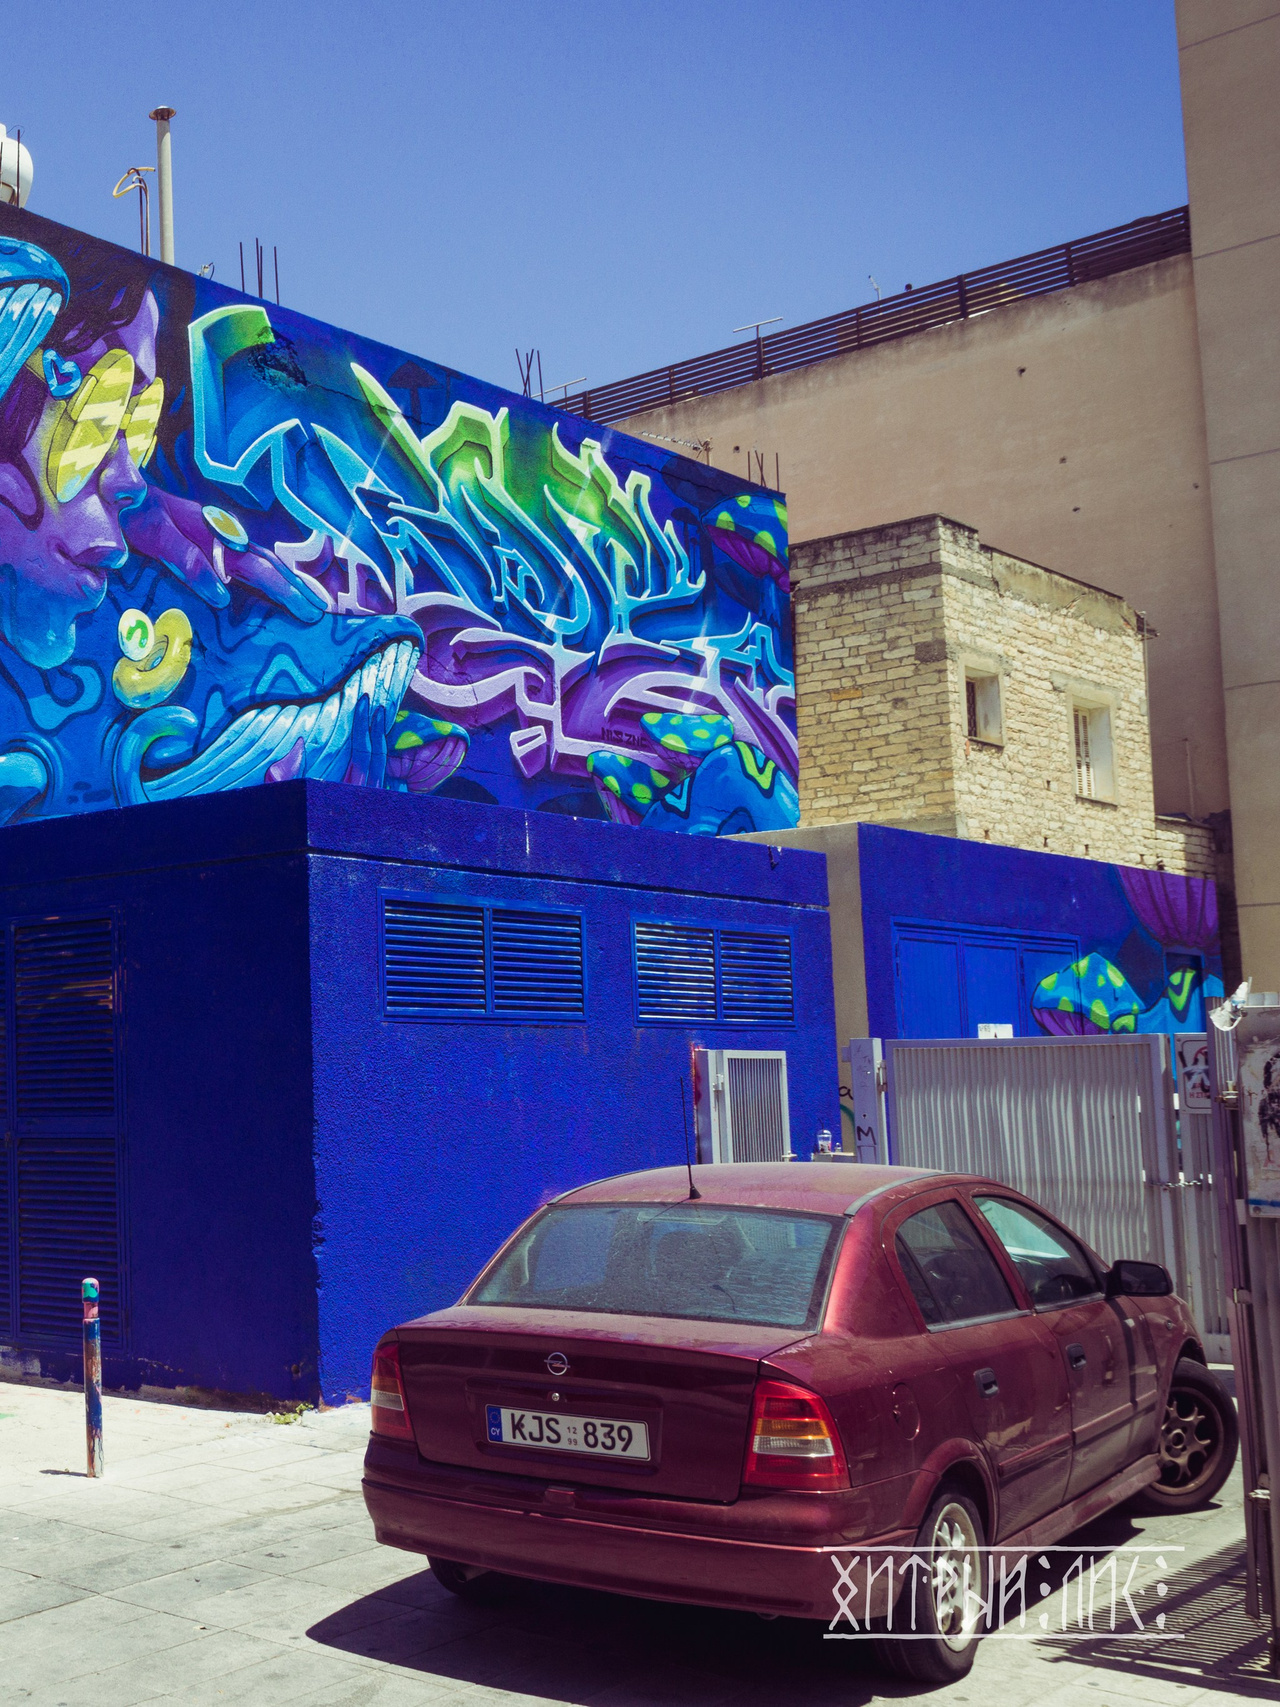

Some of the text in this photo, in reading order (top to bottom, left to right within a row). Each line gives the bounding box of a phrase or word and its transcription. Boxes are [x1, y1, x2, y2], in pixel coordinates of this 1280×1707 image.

[491, 1427, 500, 1436] CY
[510, 1412, 633, 1453] KJS 839
[567, 1426, 577, 1434] 12
[567, 1437, 578, 1446] 99
